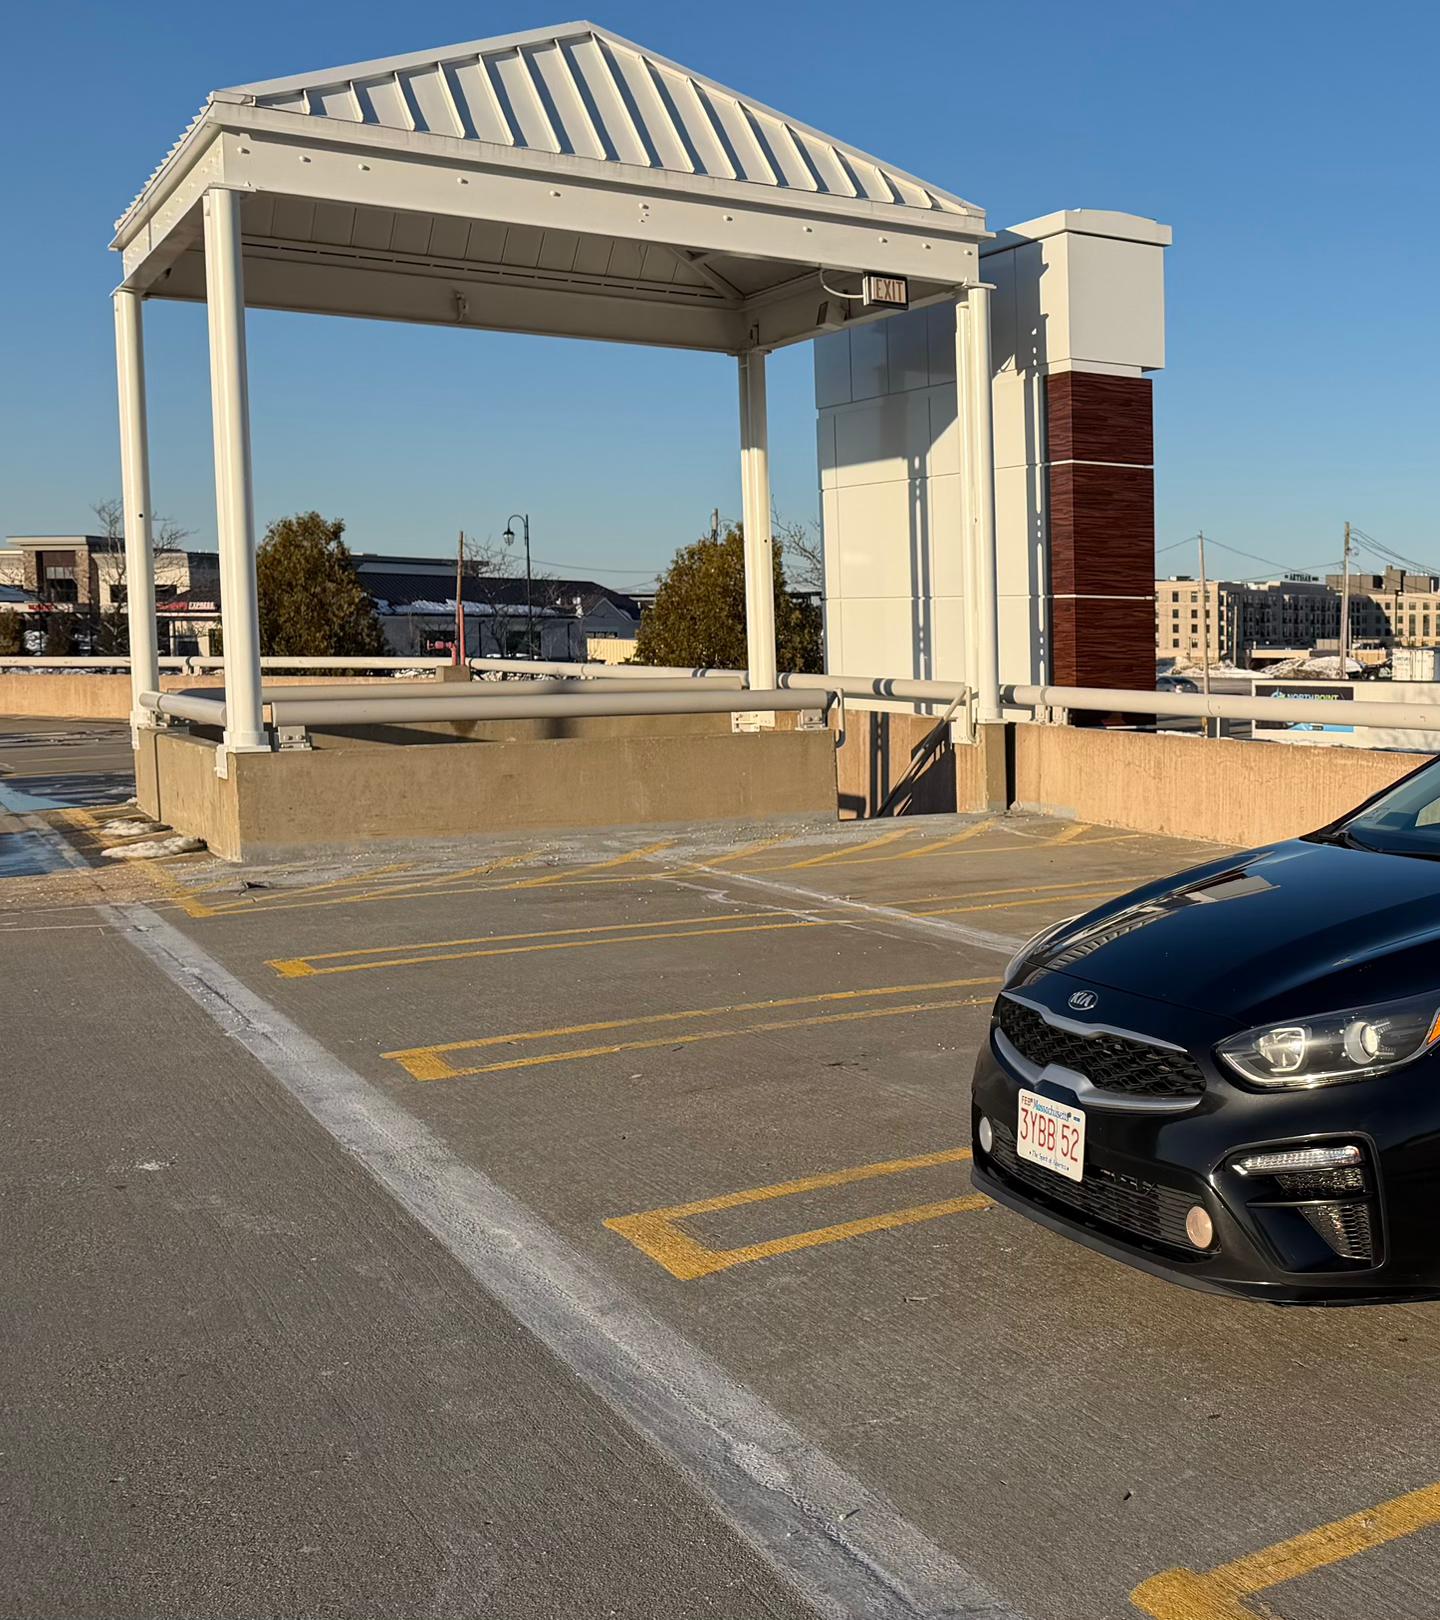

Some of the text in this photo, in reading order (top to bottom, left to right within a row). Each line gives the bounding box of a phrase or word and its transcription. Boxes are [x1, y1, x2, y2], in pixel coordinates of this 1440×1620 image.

[876, 278, 903, 302] EXIT
[1070, 991, 1093, 1007] KIA
[1020, 1107, 1080, 1163] 3YBB 52
